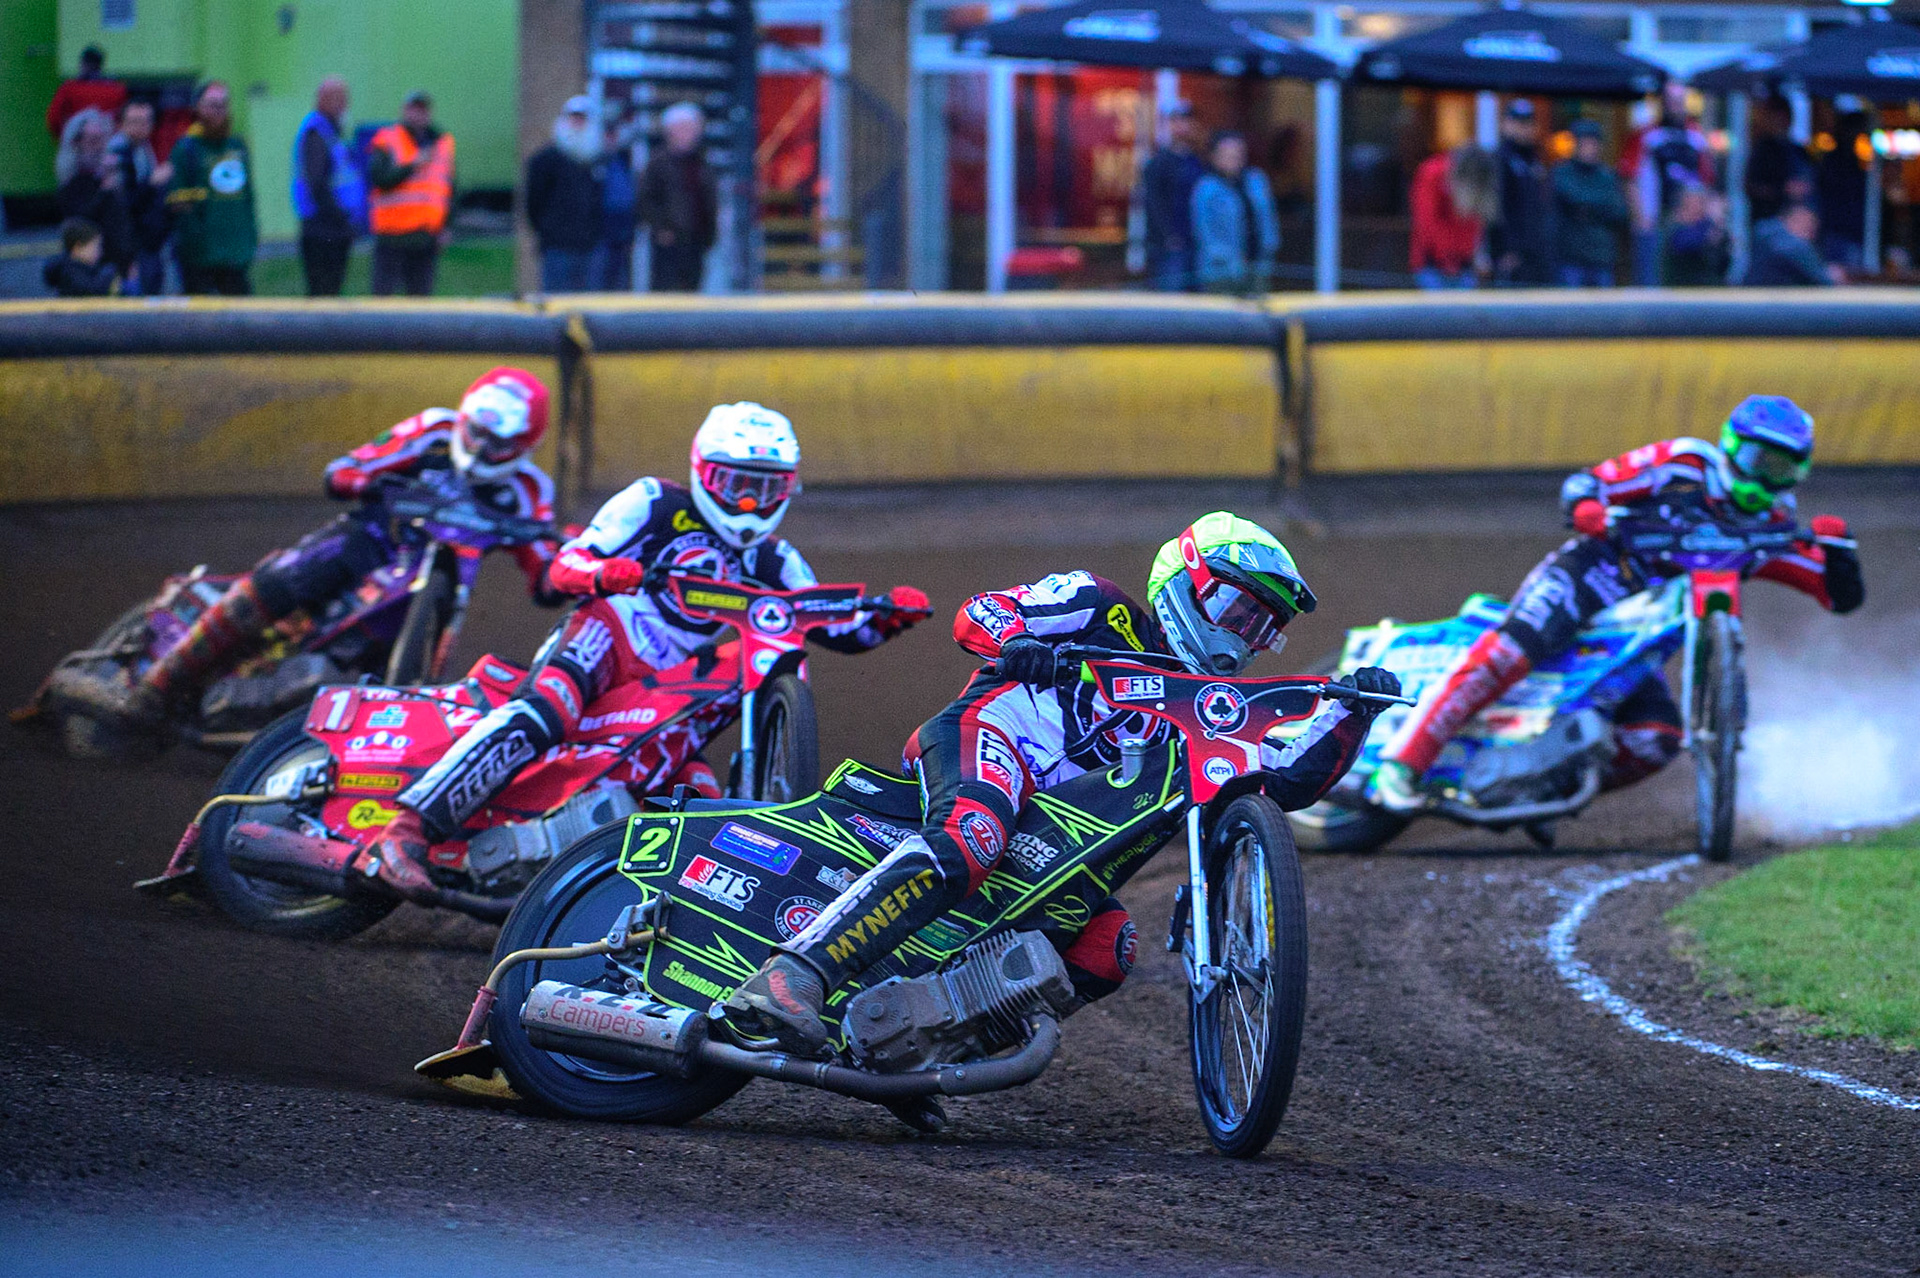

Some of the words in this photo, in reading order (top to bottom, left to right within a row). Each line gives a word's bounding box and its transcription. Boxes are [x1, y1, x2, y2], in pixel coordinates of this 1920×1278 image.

[1130, 677, 1161, 692] FTS
[324, 690, 352, 731] 1
[630, 826, 672, 862] 2
[970, 818, 1000, 855] STS
[706, 864, 760, 902] FTS
[825, 868, 935, 964] MYNEFIT
[662, 960, 723, 999] Shannon
[549, 998, 646, 1038] Campers
